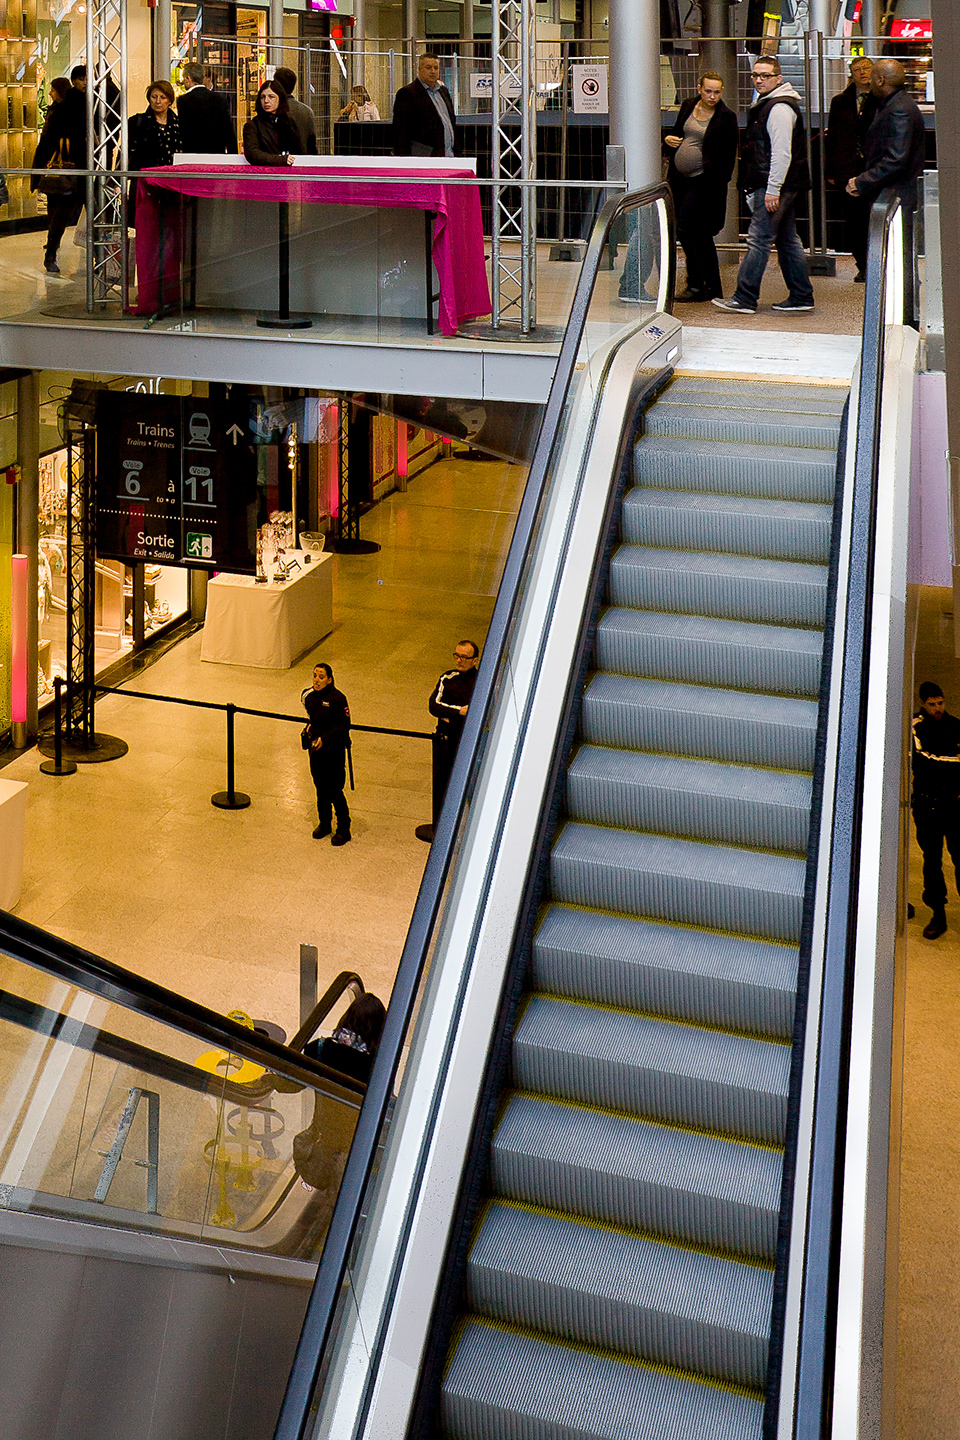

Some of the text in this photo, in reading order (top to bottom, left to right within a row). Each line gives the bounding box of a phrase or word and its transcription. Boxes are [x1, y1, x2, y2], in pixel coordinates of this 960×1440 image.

[137, 422, 175, 438] Trains
[127, 438, 175, 449] Trains Trenes
[125, 470, 213, 503] 6 à 11
[137, 531, 175, 548] Sortie
[133, 547, 175, 559] Exit Salida
